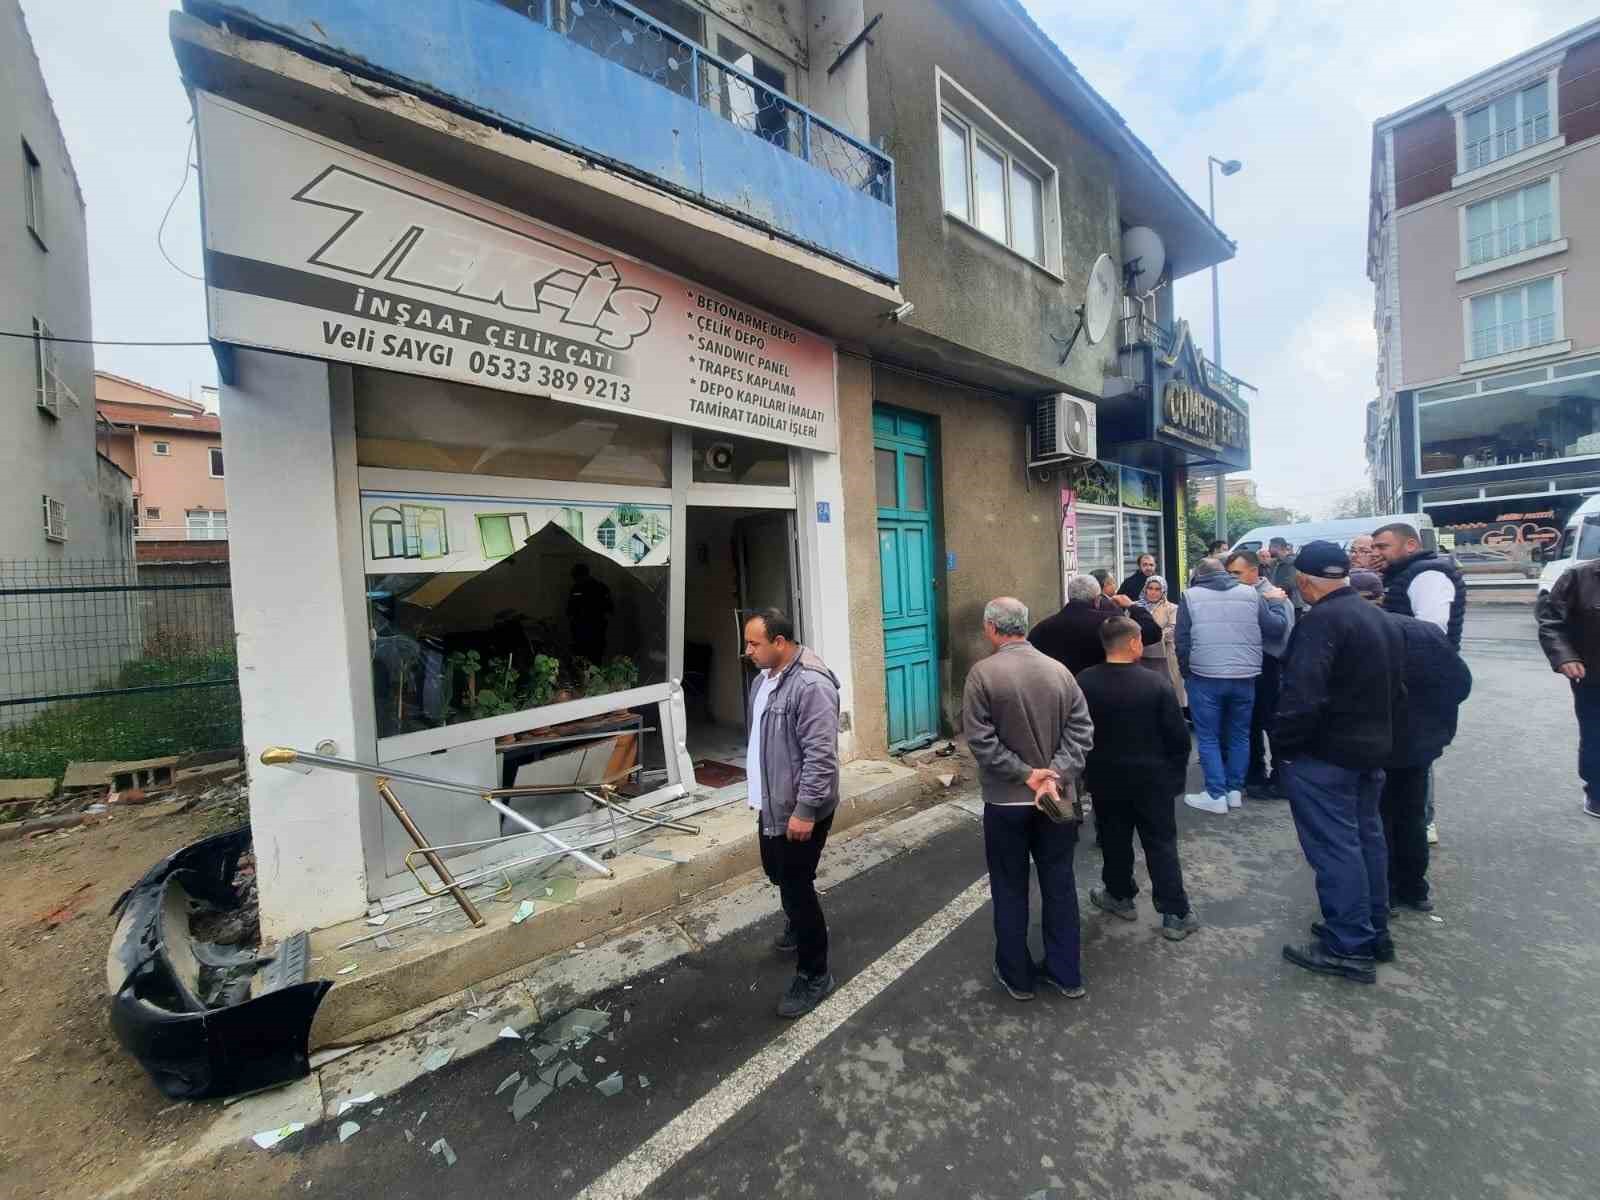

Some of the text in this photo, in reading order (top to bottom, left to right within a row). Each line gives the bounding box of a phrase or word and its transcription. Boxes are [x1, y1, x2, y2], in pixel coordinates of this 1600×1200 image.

[354, 288, 613, 370] İNŞAAT ÇELİK ÇATI
[697, 295, 769, 333] BETONARME
[735, 331, 766, 350] DEPO
[322, 320, 631, 403] Veli SAYGI 0533 389 9213
[698, 358, 797, 398] TRAPES KAPLAMA
[758, 357, 790, 378] PANEL
[700, 380, 735, 399] DEPO
[736, 390, 787, 413] KAPILARI
[690, 398, 746, 421] TAMİRAT
[746, 412, 789, 432] TADİLAT
